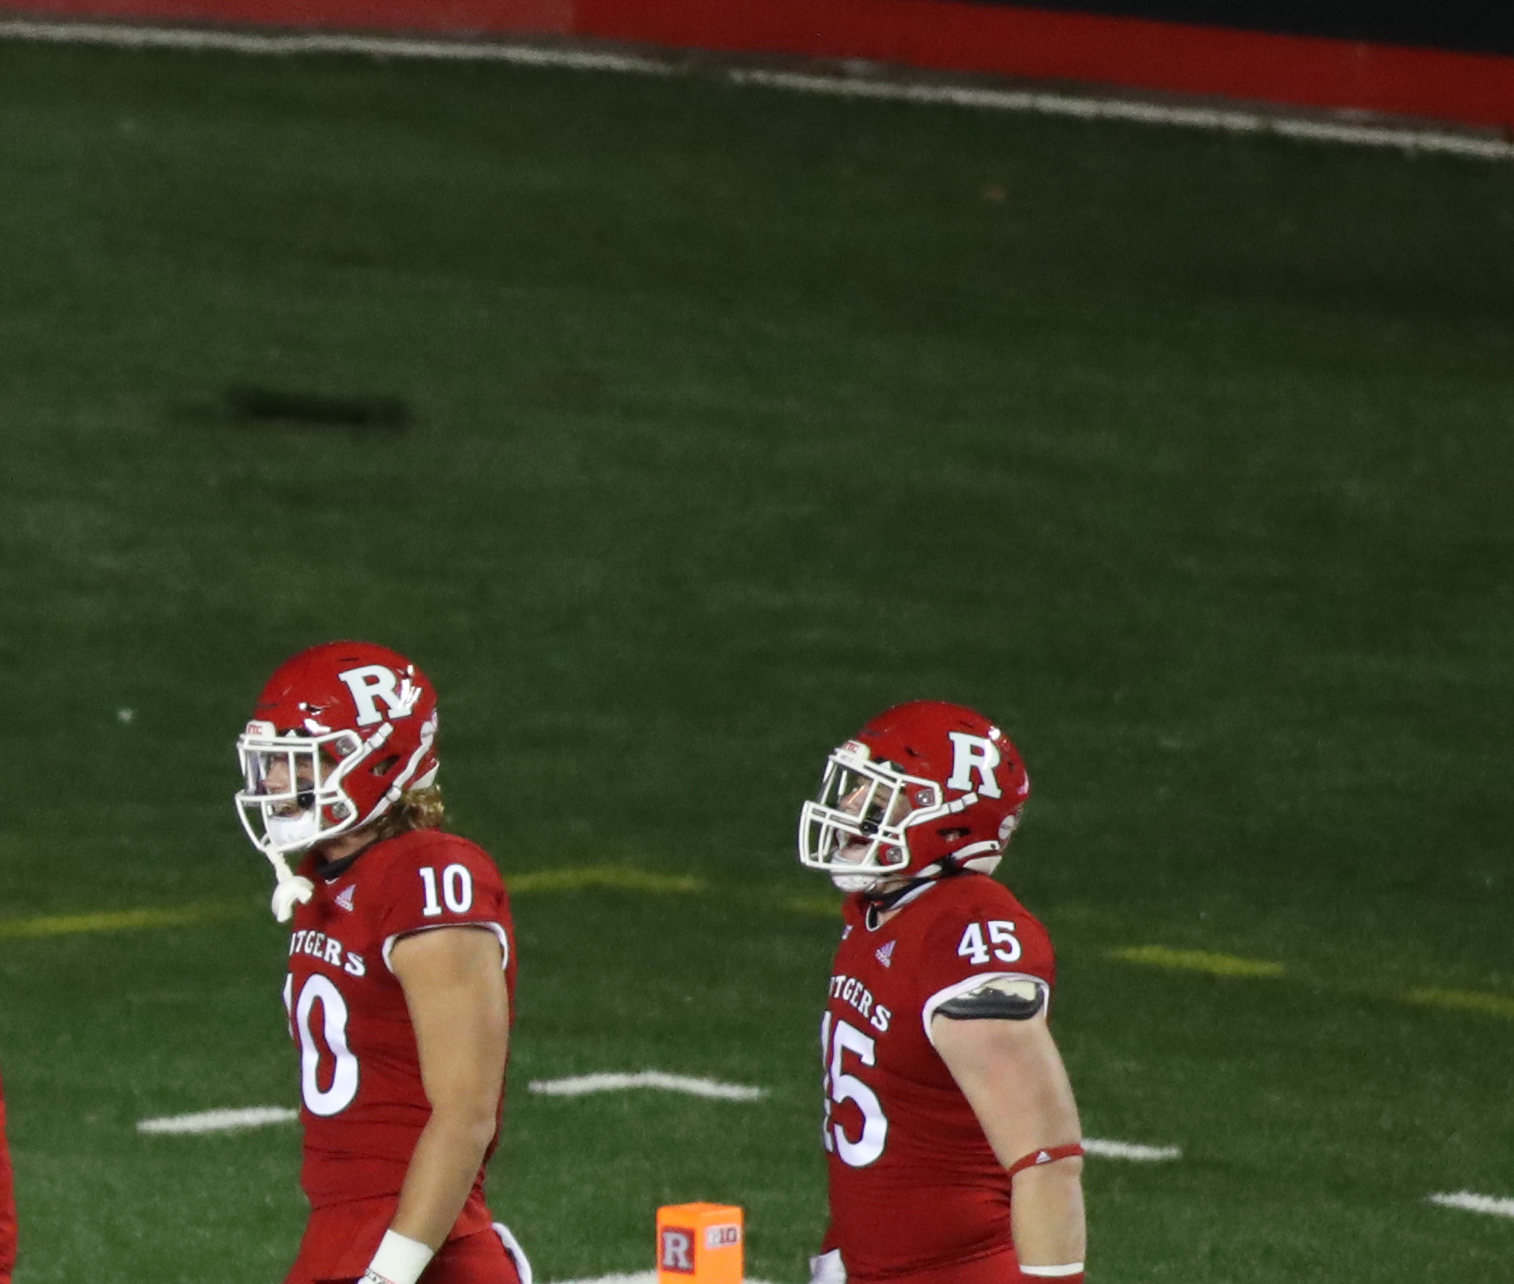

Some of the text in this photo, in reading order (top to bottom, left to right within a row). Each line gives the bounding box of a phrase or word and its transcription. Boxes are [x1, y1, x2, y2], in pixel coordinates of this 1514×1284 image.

[339, 664, 412, 727] R
[947, 731, 1001, 799] R
[420, 864, 472, 917] 10
[957, 920, 1021, 965] 45
[283, 973, 359, 1117] 0
[663, 1231, 693, 1271] R
